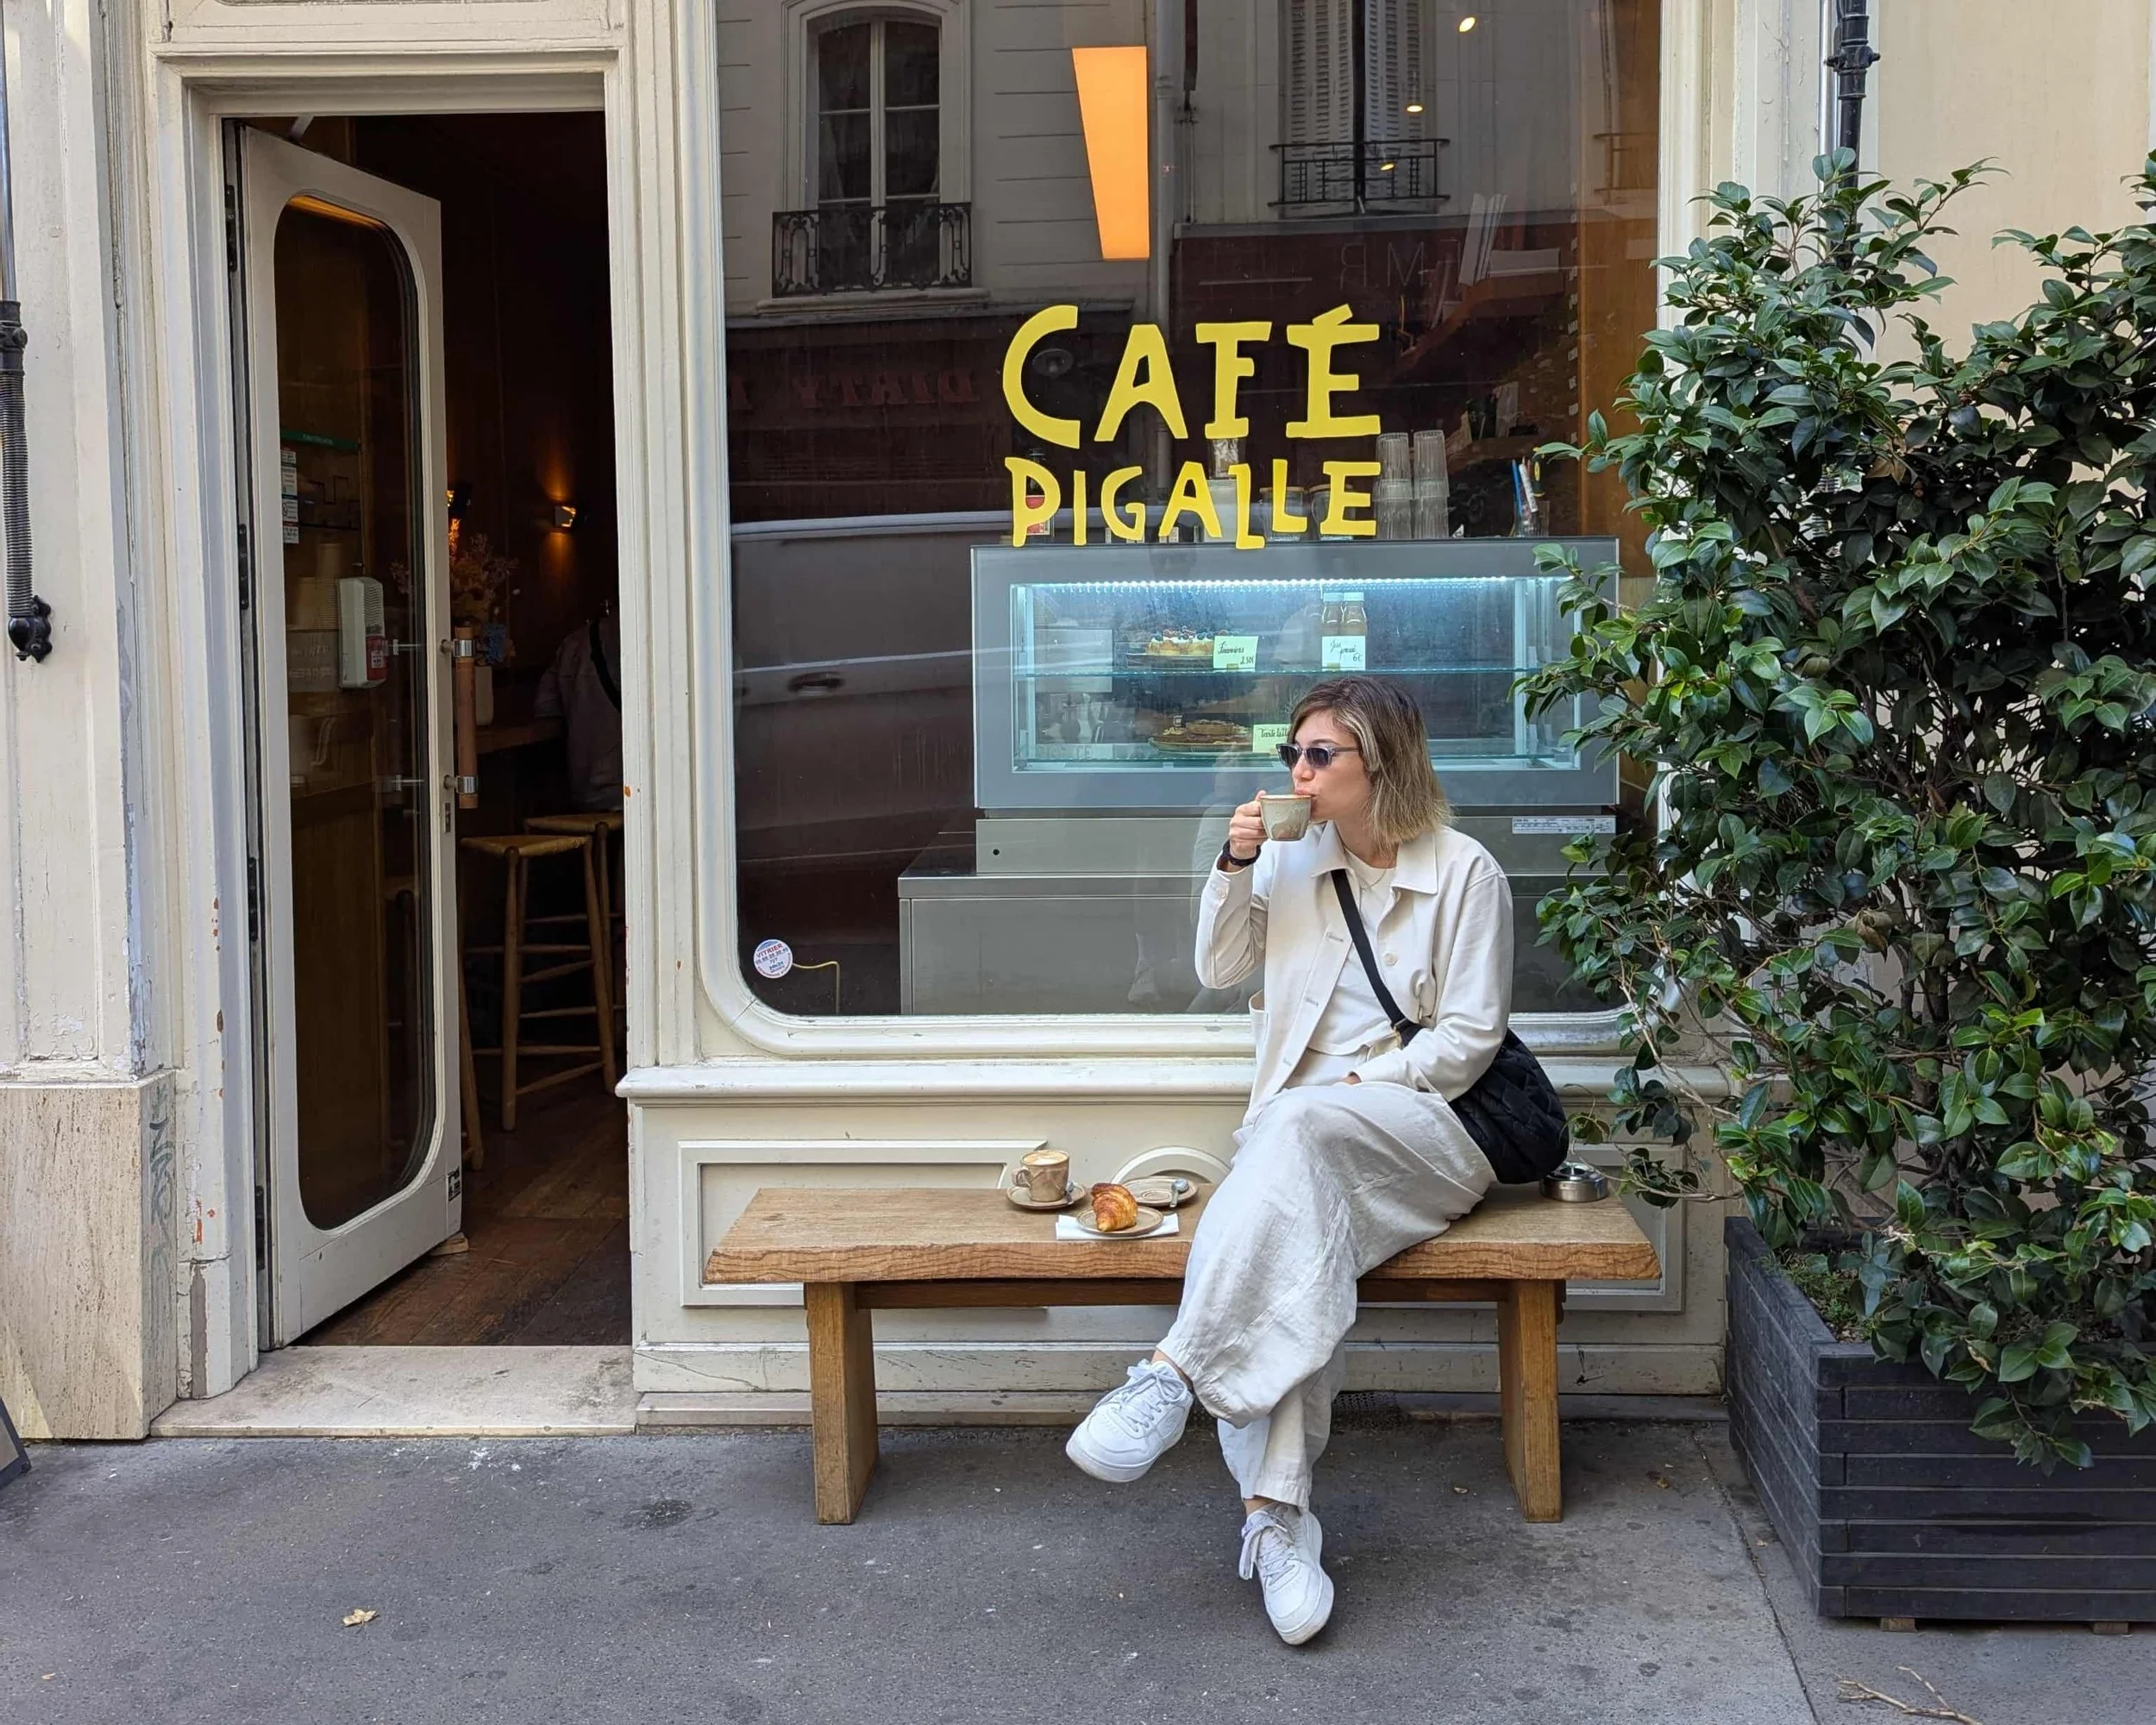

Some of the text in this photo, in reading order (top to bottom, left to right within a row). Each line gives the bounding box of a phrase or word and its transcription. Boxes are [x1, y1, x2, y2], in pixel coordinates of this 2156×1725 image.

[1002, 304, 1381, 448] CAFÉ
[1004, 456, 1381, 550] PIGALLE
[755, 943, 783, 958] VITRIER
